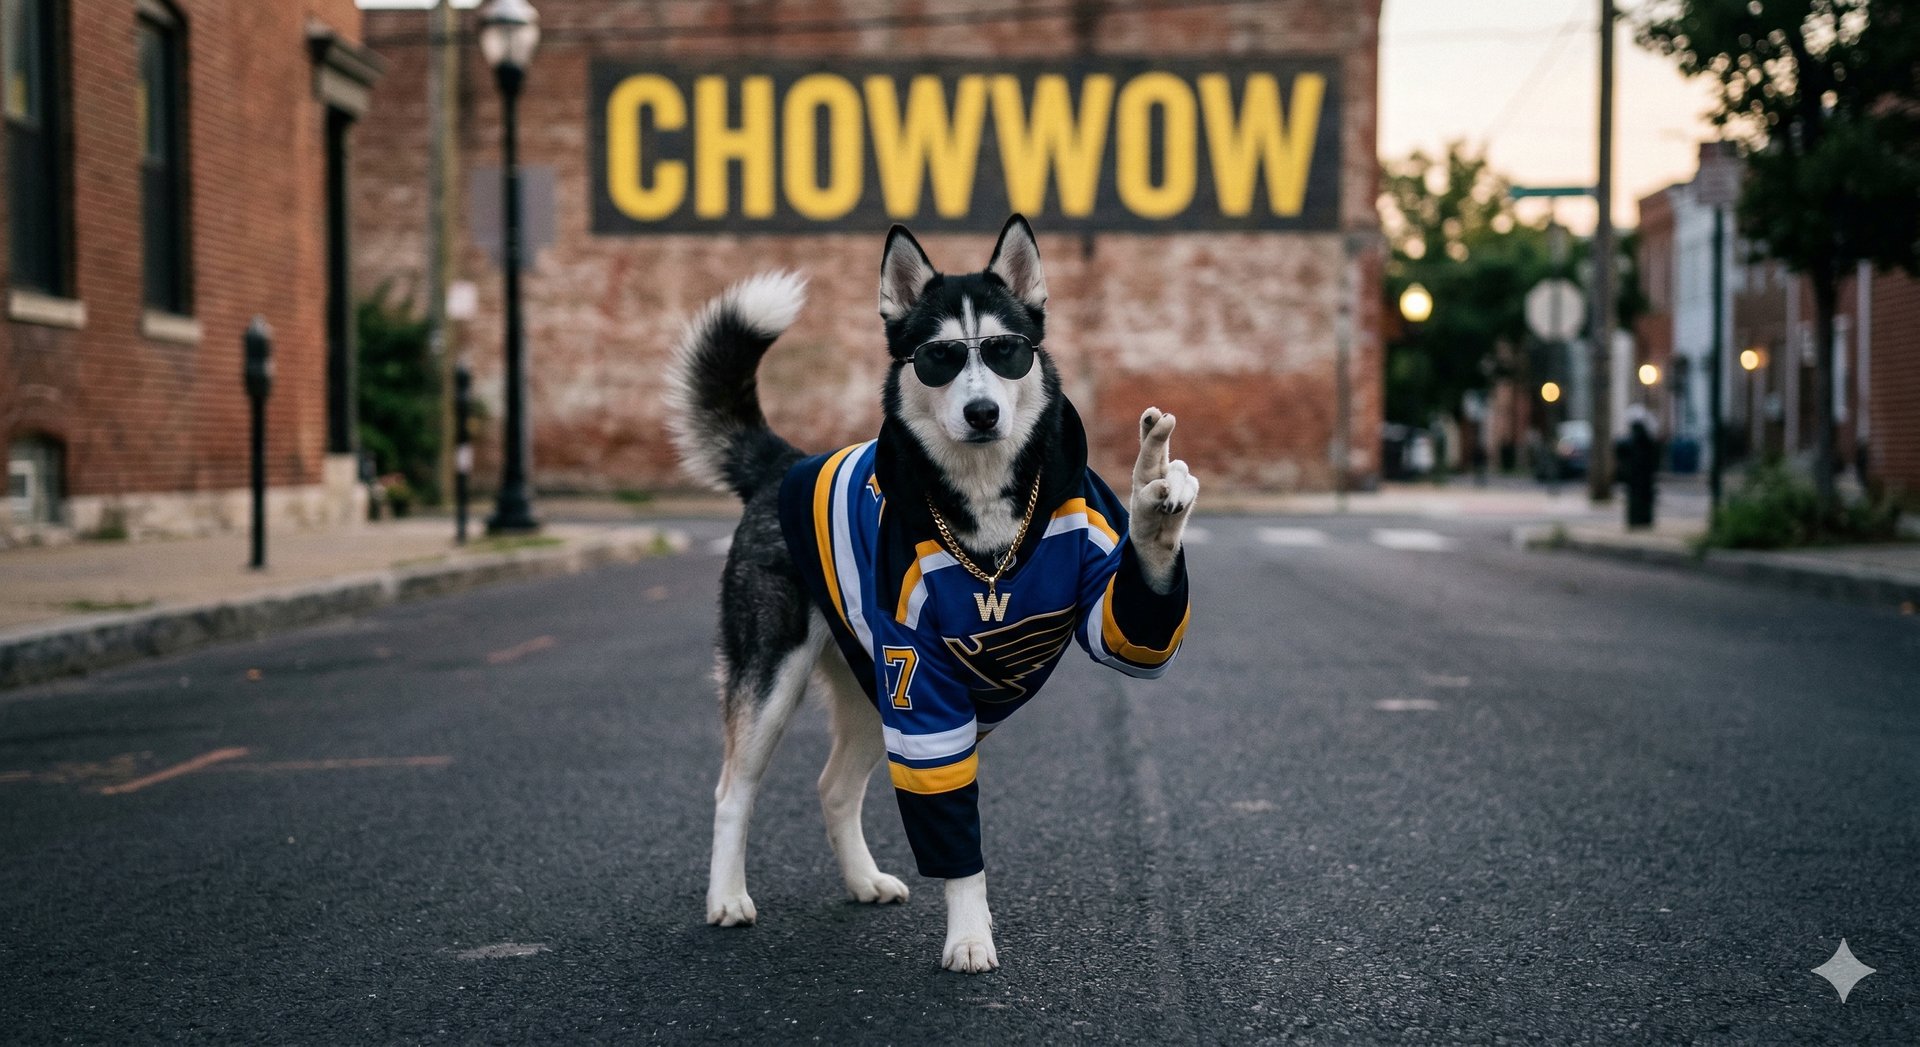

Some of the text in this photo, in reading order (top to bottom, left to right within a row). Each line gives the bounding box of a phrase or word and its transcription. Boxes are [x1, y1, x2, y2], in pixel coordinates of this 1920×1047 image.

[606, 72, 1325, 222] CHOWWOW
[973, 592, 1012, 622] W
[882, 645, 919, 710] 7
